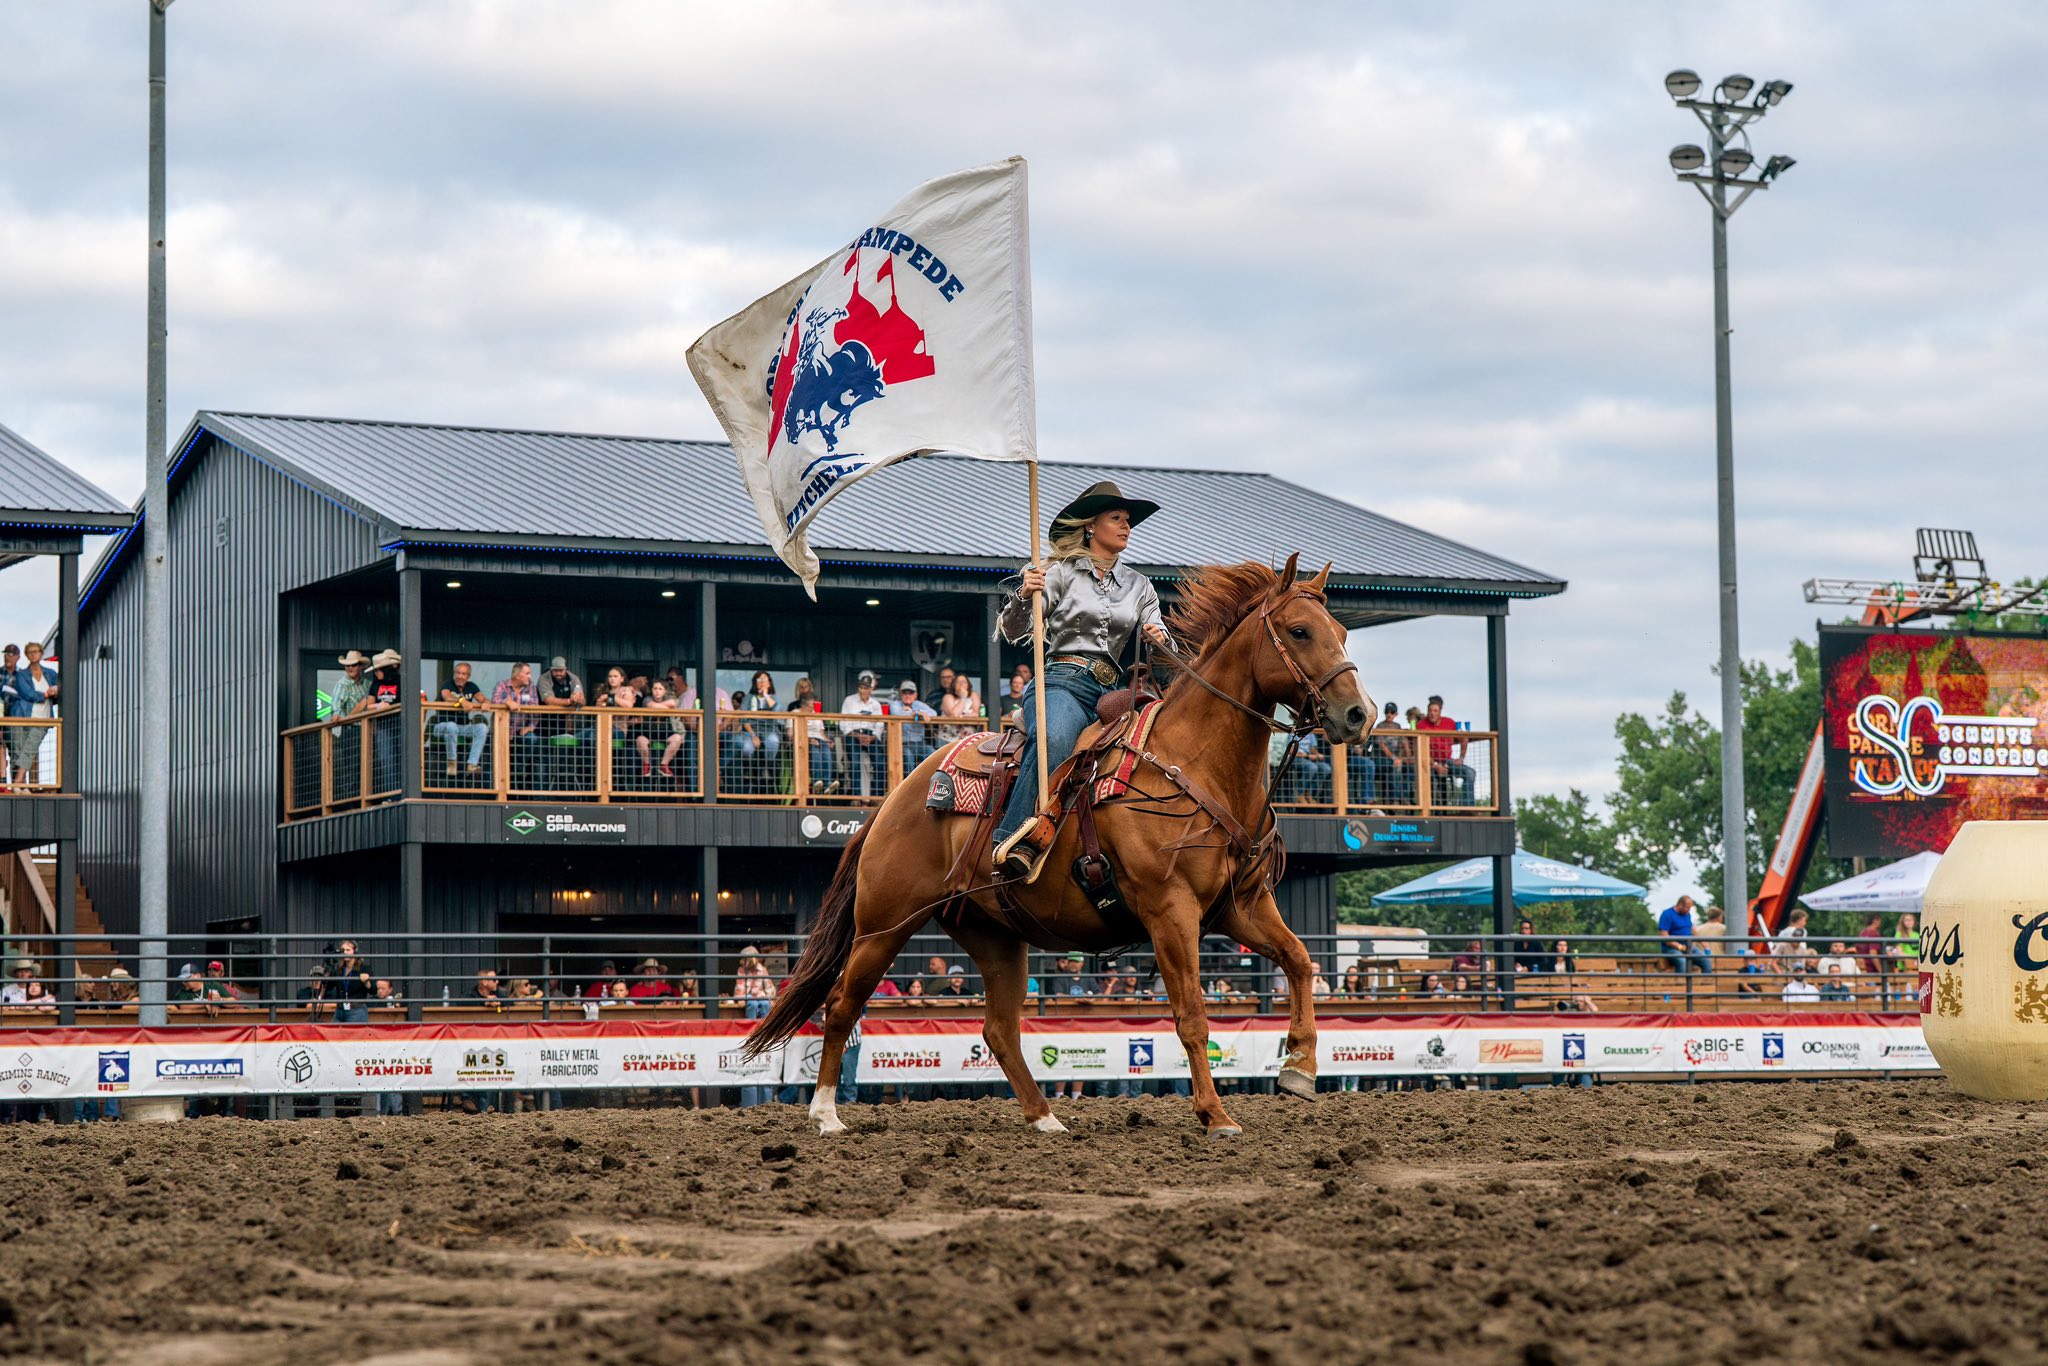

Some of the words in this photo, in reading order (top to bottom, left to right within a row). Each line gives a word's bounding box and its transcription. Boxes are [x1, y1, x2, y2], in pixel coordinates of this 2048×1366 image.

[848, 226, 965, 303] AMPEDE
[1938, 725, 2032, 745] SCHMITZ
[546, 814, 574, 824] C&B
[546, 823, 626, 832] OPERATIONS
[1704, 1039, 1744, 1051] BIG-E
[540, 1050, 570, 1061] BAILEY
[572, 1049, 600, 1060] METAL
[656, 1051, 696, 1060] PALCE
[904, 1050, 940, 1058] PALCE
[1332, 1053, 1394, 1061] STAMPEDE
[1704, 1053, 1728, 1062] AUTO
[391, 1056, 432, 1064] PALCE
[466, 1054, 476, 1067] M
[481, 1054, 490, 1064] &
[496, 1054, 504, 1067] S
[872, 1059, 941, 1068] STAMPEDE
[158, 1061, 240, 1075] GRAHAM
[354, 1066, 433, 1076] STAMPEDE
[542, 1064, 599, 1076] FABRICATORS
[623, 1062, 696, 1070] STAMPEDE
[36, 1069, 70, 1086] RANCH
